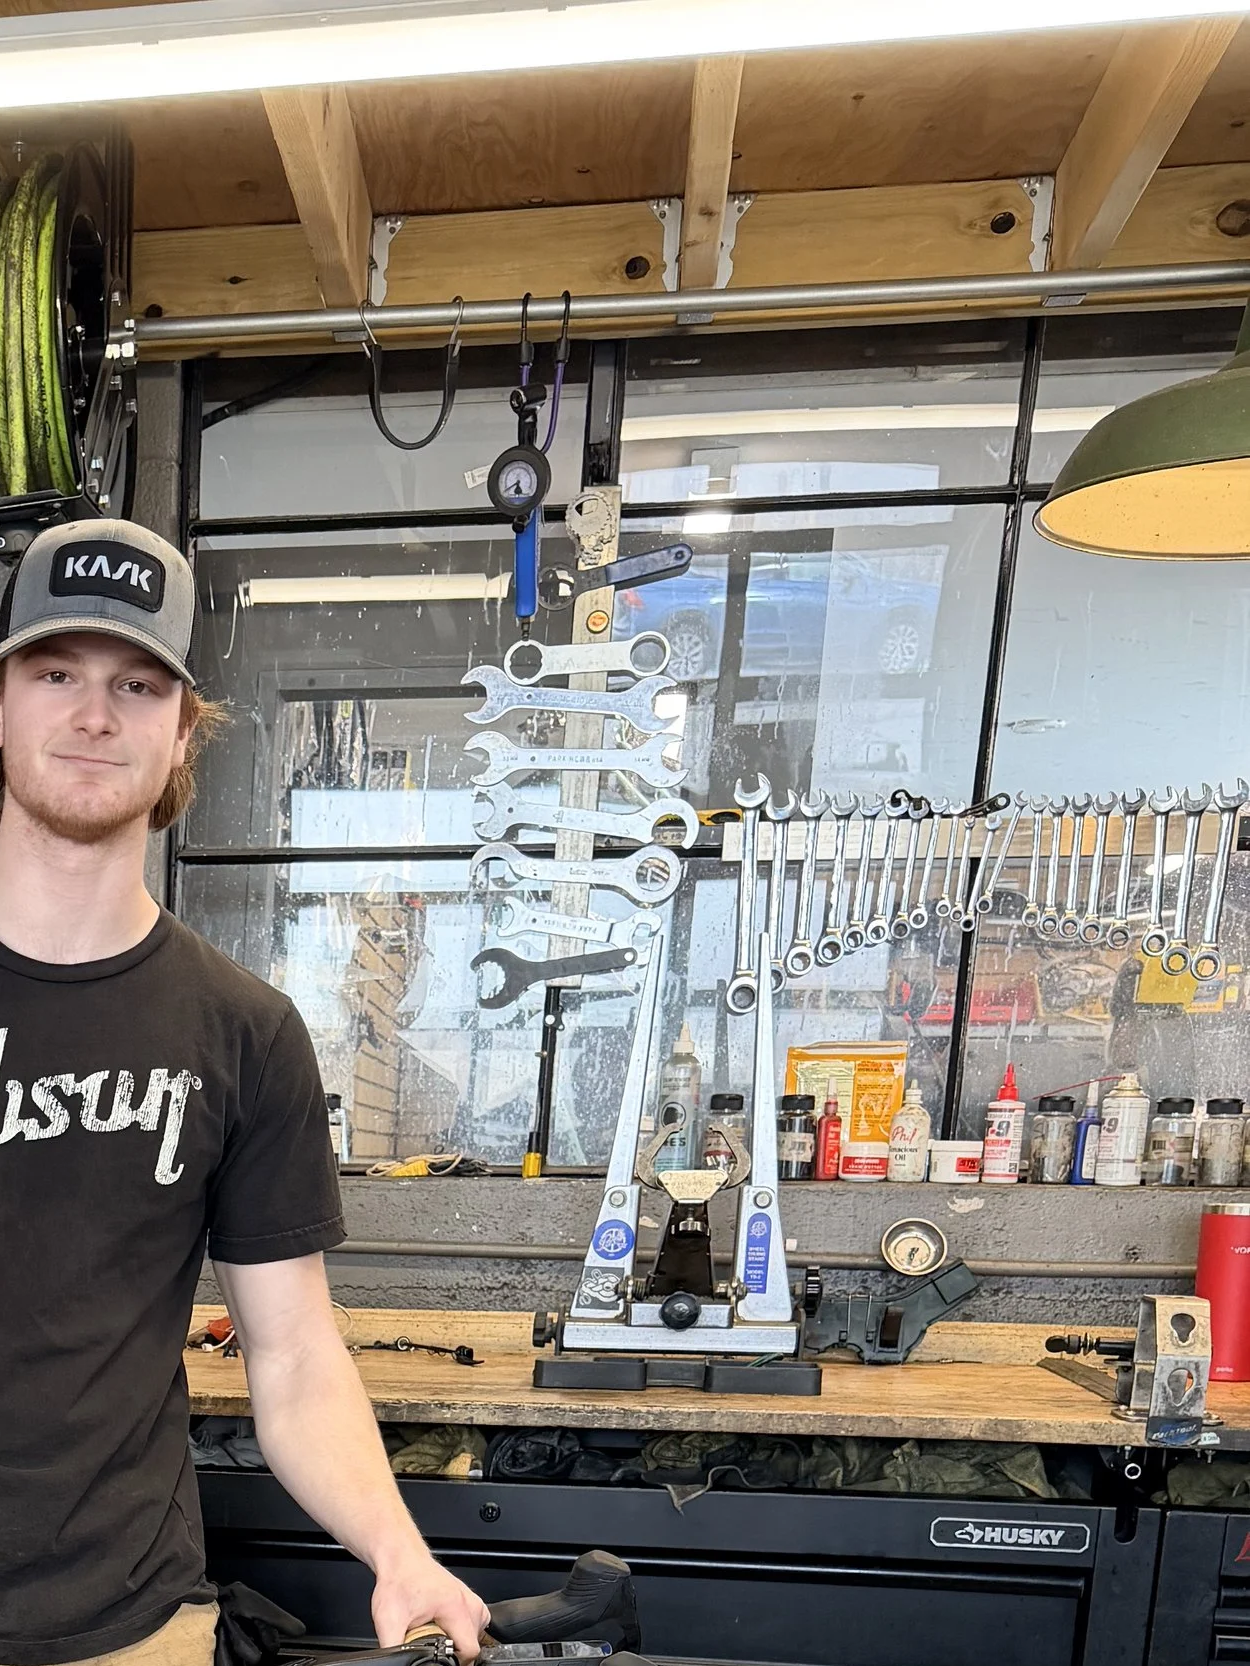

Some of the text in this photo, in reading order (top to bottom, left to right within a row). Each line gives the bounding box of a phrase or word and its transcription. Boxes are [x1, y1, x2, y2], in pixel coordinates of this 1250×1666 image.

[64, 554, 153, 593] KASK
[891, 1126, 918, 1144] Phil
[983, 1526, 1065, 1546] HUSKY
